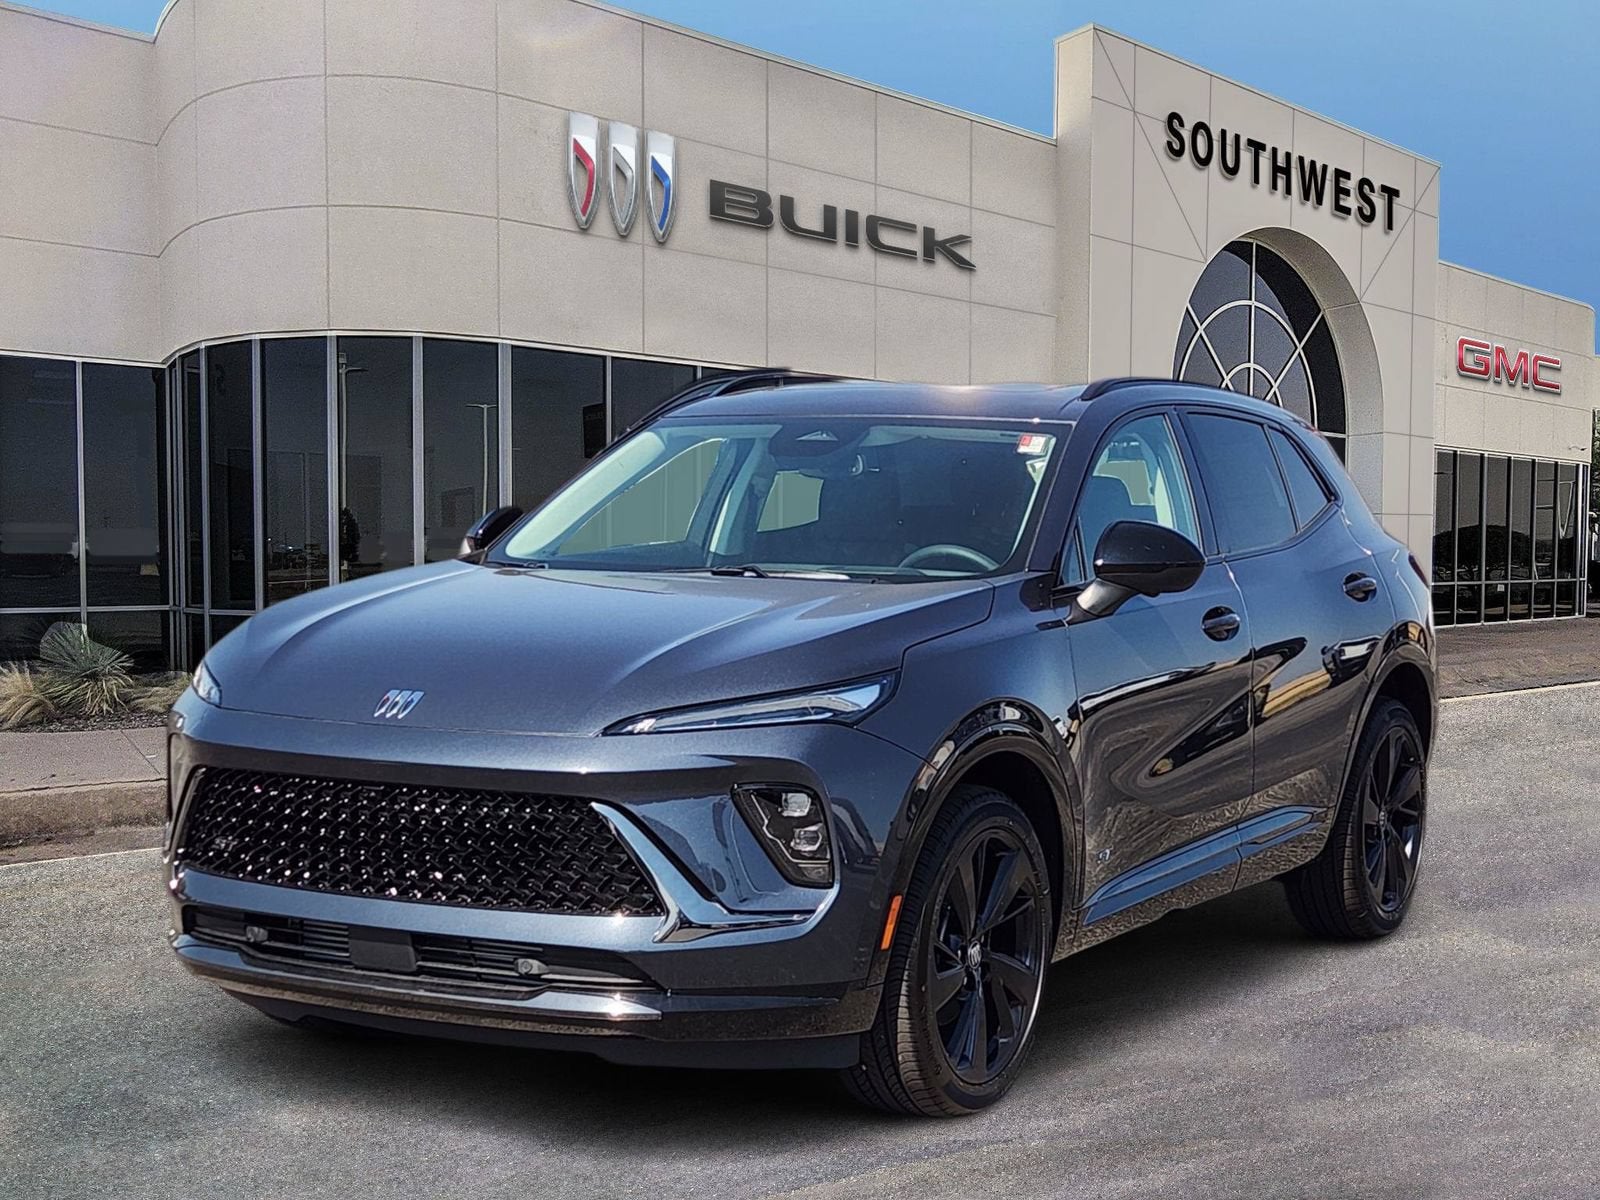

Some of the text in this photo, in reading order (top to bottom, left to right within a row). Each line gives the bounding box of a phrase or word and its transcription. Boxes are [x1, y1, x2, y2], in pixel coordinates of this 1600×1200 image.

[1165, 111, 1400, 232] SOUTHWEST
[709, 179, 977, 271] BUICK
[1457, 335, 1562, 395] GMC
